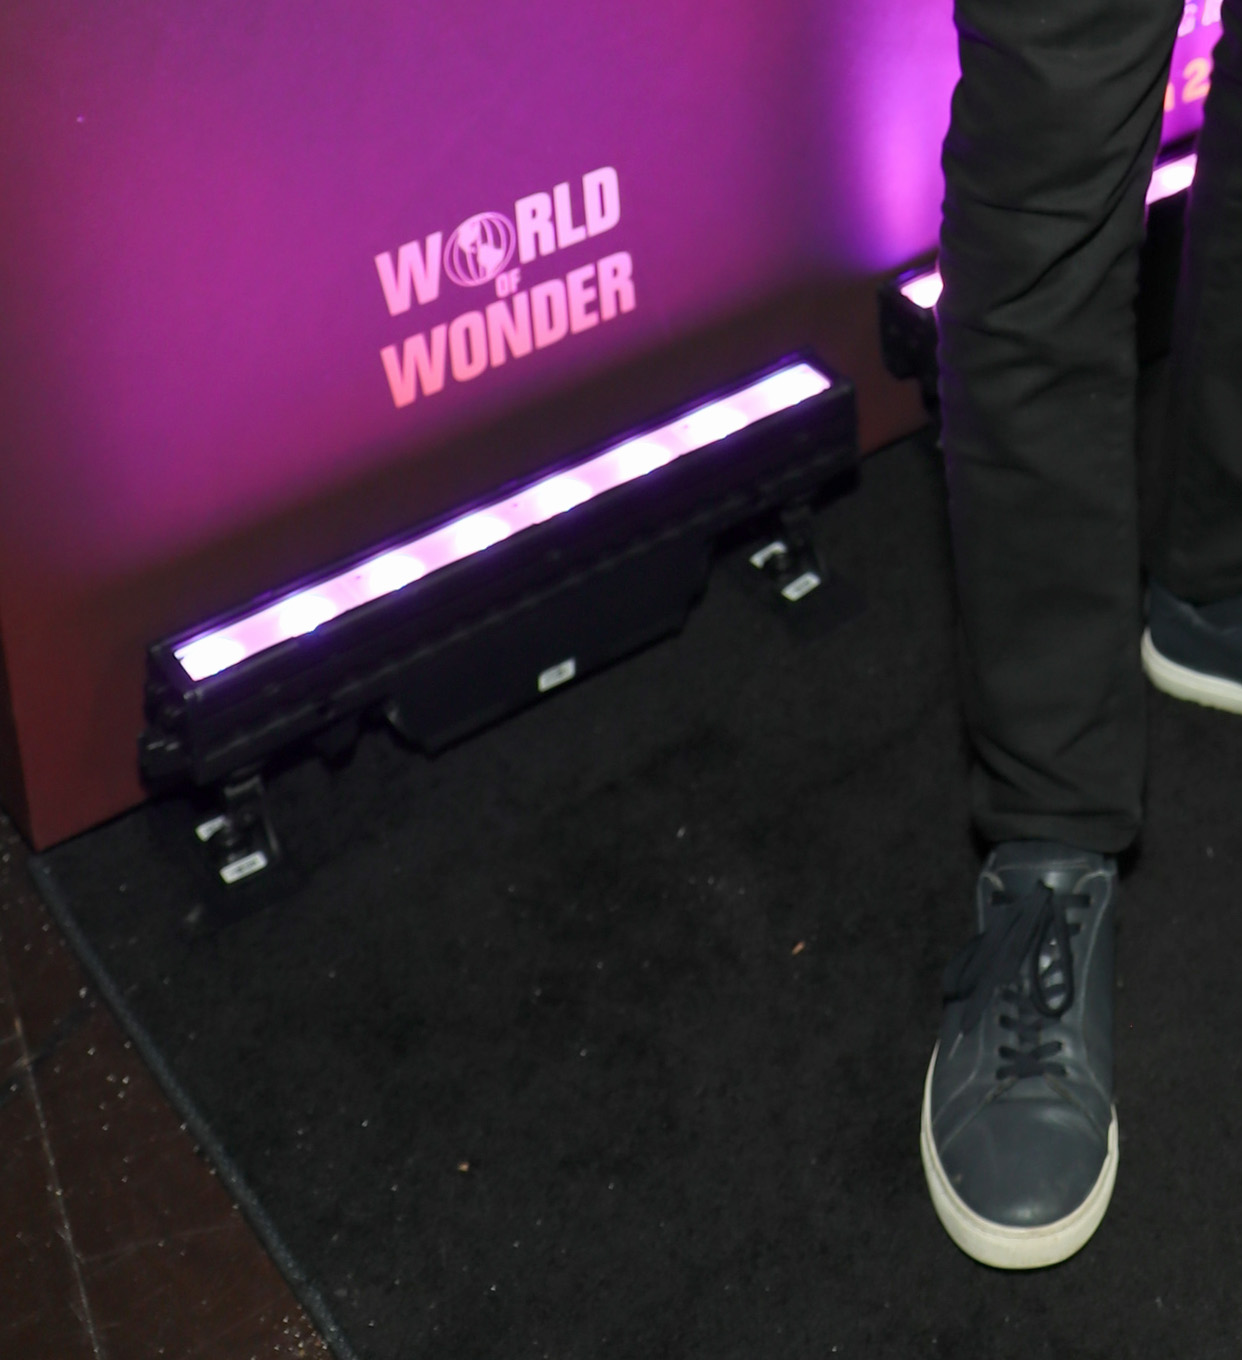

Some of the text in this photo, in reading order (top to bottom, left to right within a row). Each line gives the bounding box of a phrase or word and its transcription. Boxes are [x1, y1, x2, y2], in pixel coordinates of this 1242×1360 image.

[374, 166, 621, 317] WORLD
[495, 268, 521, 299] OF
[379, 251, 637, 409] WONDER
